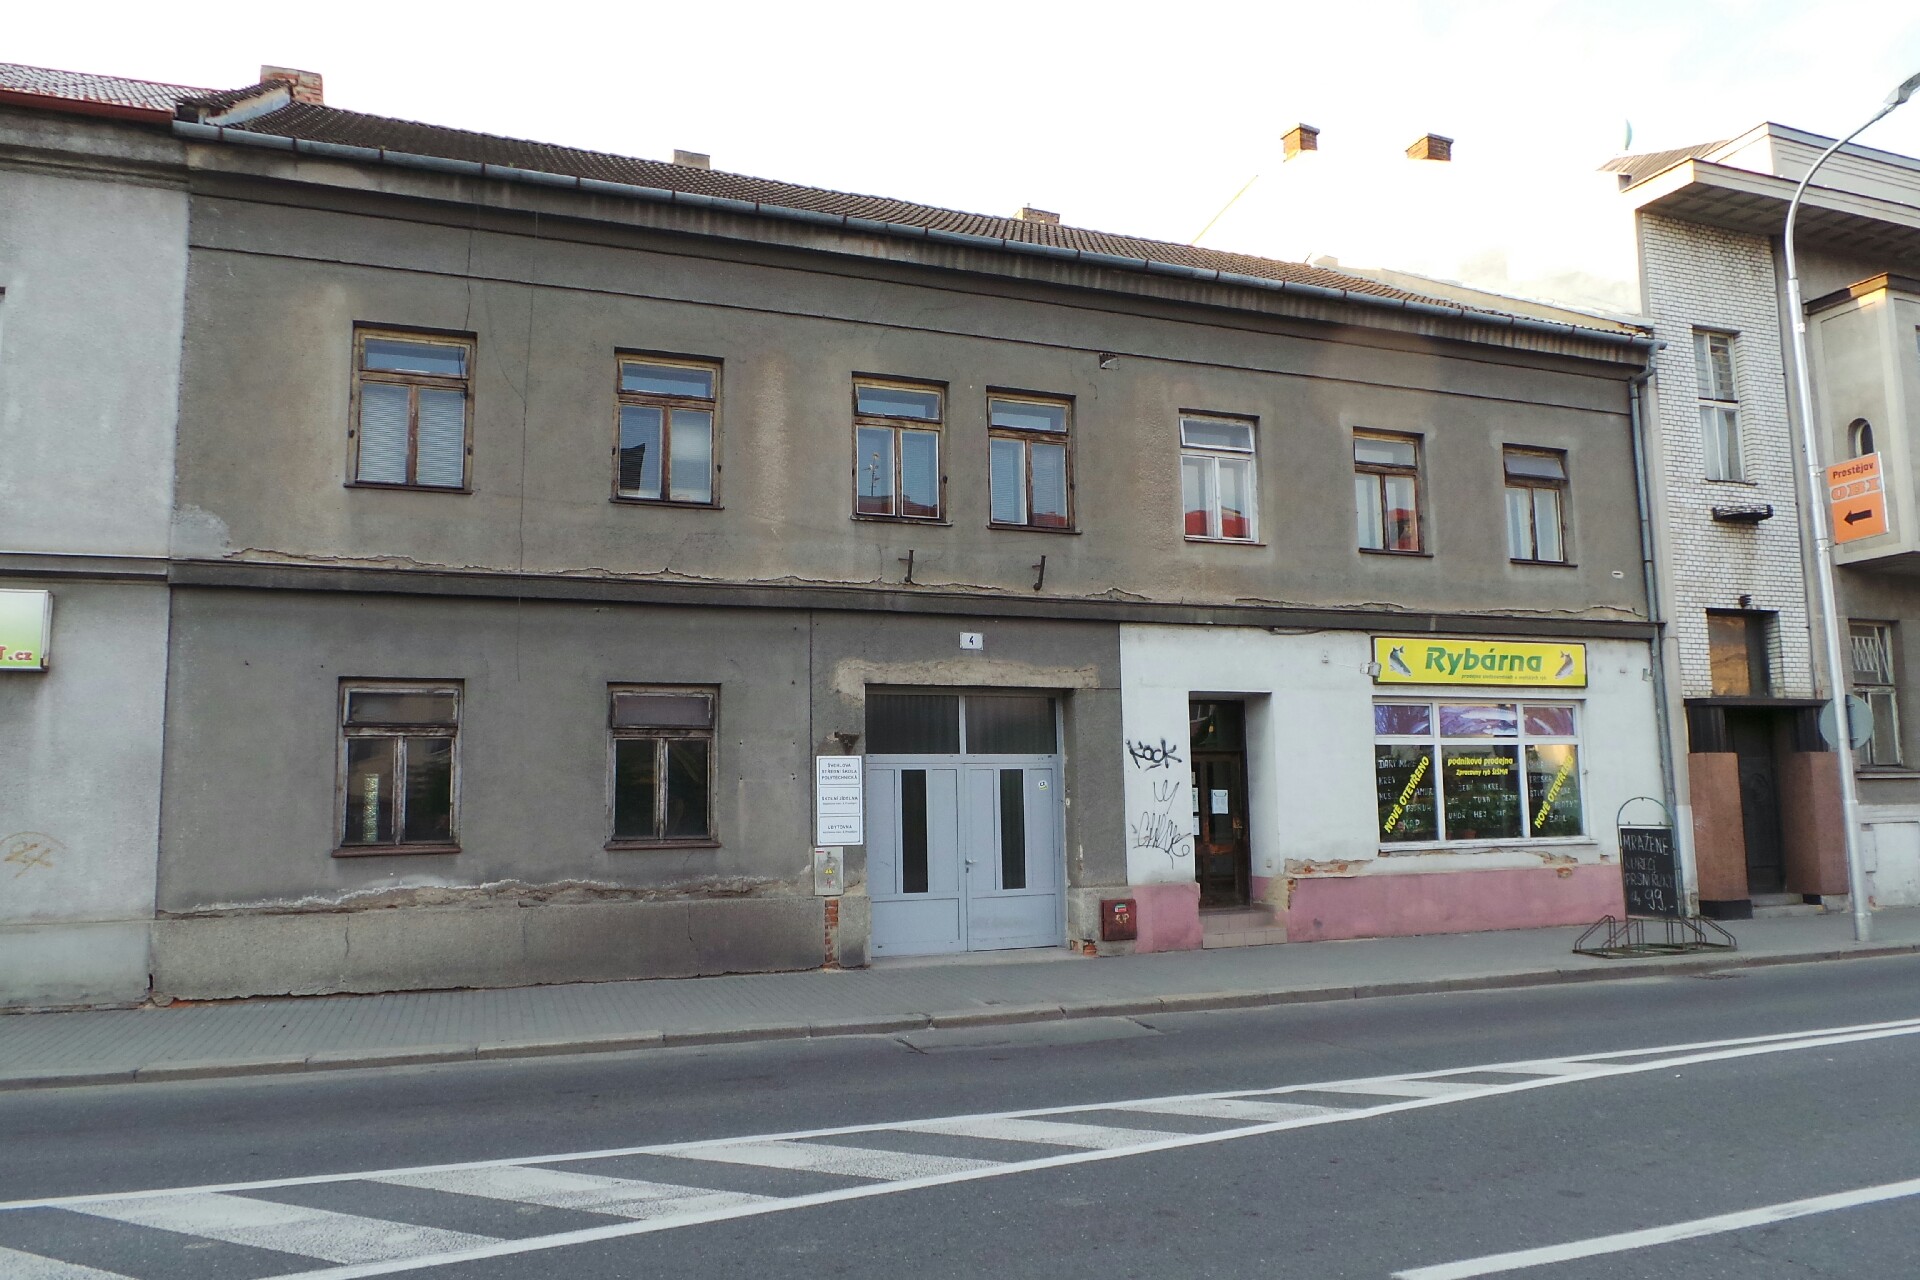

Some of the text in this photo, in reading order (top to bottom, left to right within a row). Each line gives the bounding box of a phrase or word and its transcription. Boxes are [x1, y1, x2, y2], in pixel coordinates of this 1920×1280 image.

[1833, 462, 1874, 480] Prostějov
[1831, 477, 1881, 502] OBI
[969, 635, 975, 646] 4
[1425, 647, 1543, 676] Rybárna
[1483, 757, 1513, 766] prodejna
[1383, 755, 1430, 834] NOVĚ OTEVŘENO
